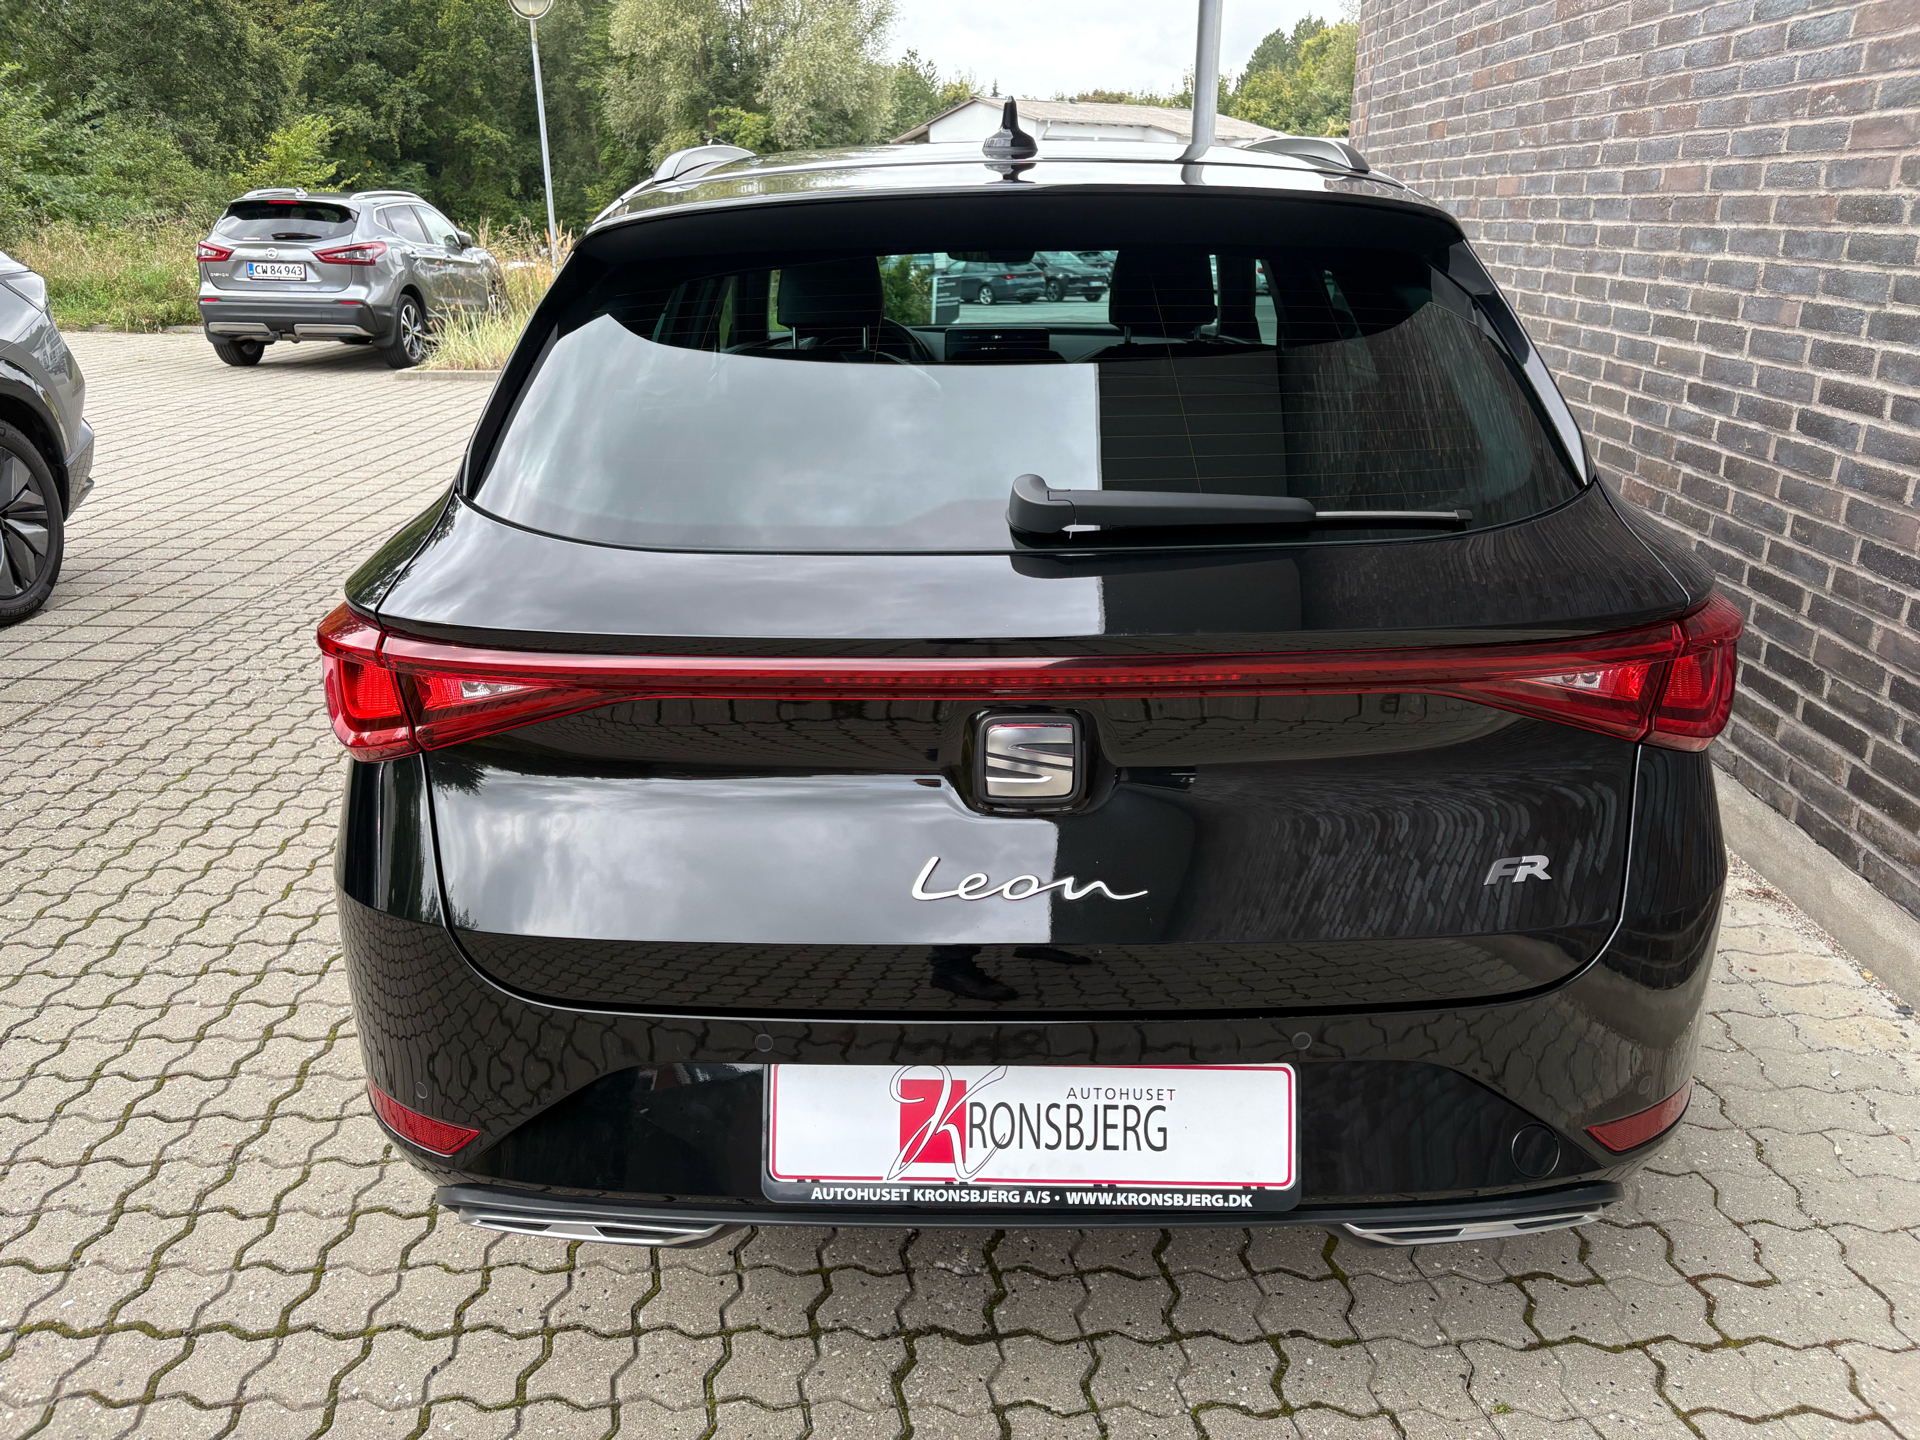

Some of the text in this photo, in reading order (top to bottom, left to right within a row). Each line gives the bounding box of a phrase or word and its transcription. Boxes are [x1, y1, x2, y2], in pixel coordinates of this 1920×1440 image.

[254, 264, 303, 276] CW 84 943
[911, 855, 1149, 901] Leon
[1483, 854, 1552, 886] FR
[1066, 1087, 1176, 1101] AUTOHUSET
[886, 1064, 1169, 1181] KRONSBJERG
[811, 1187, 1253, 1208] AUTOHUSET KRONSBJERG A/S WWW.KRONSBJERG.DK
